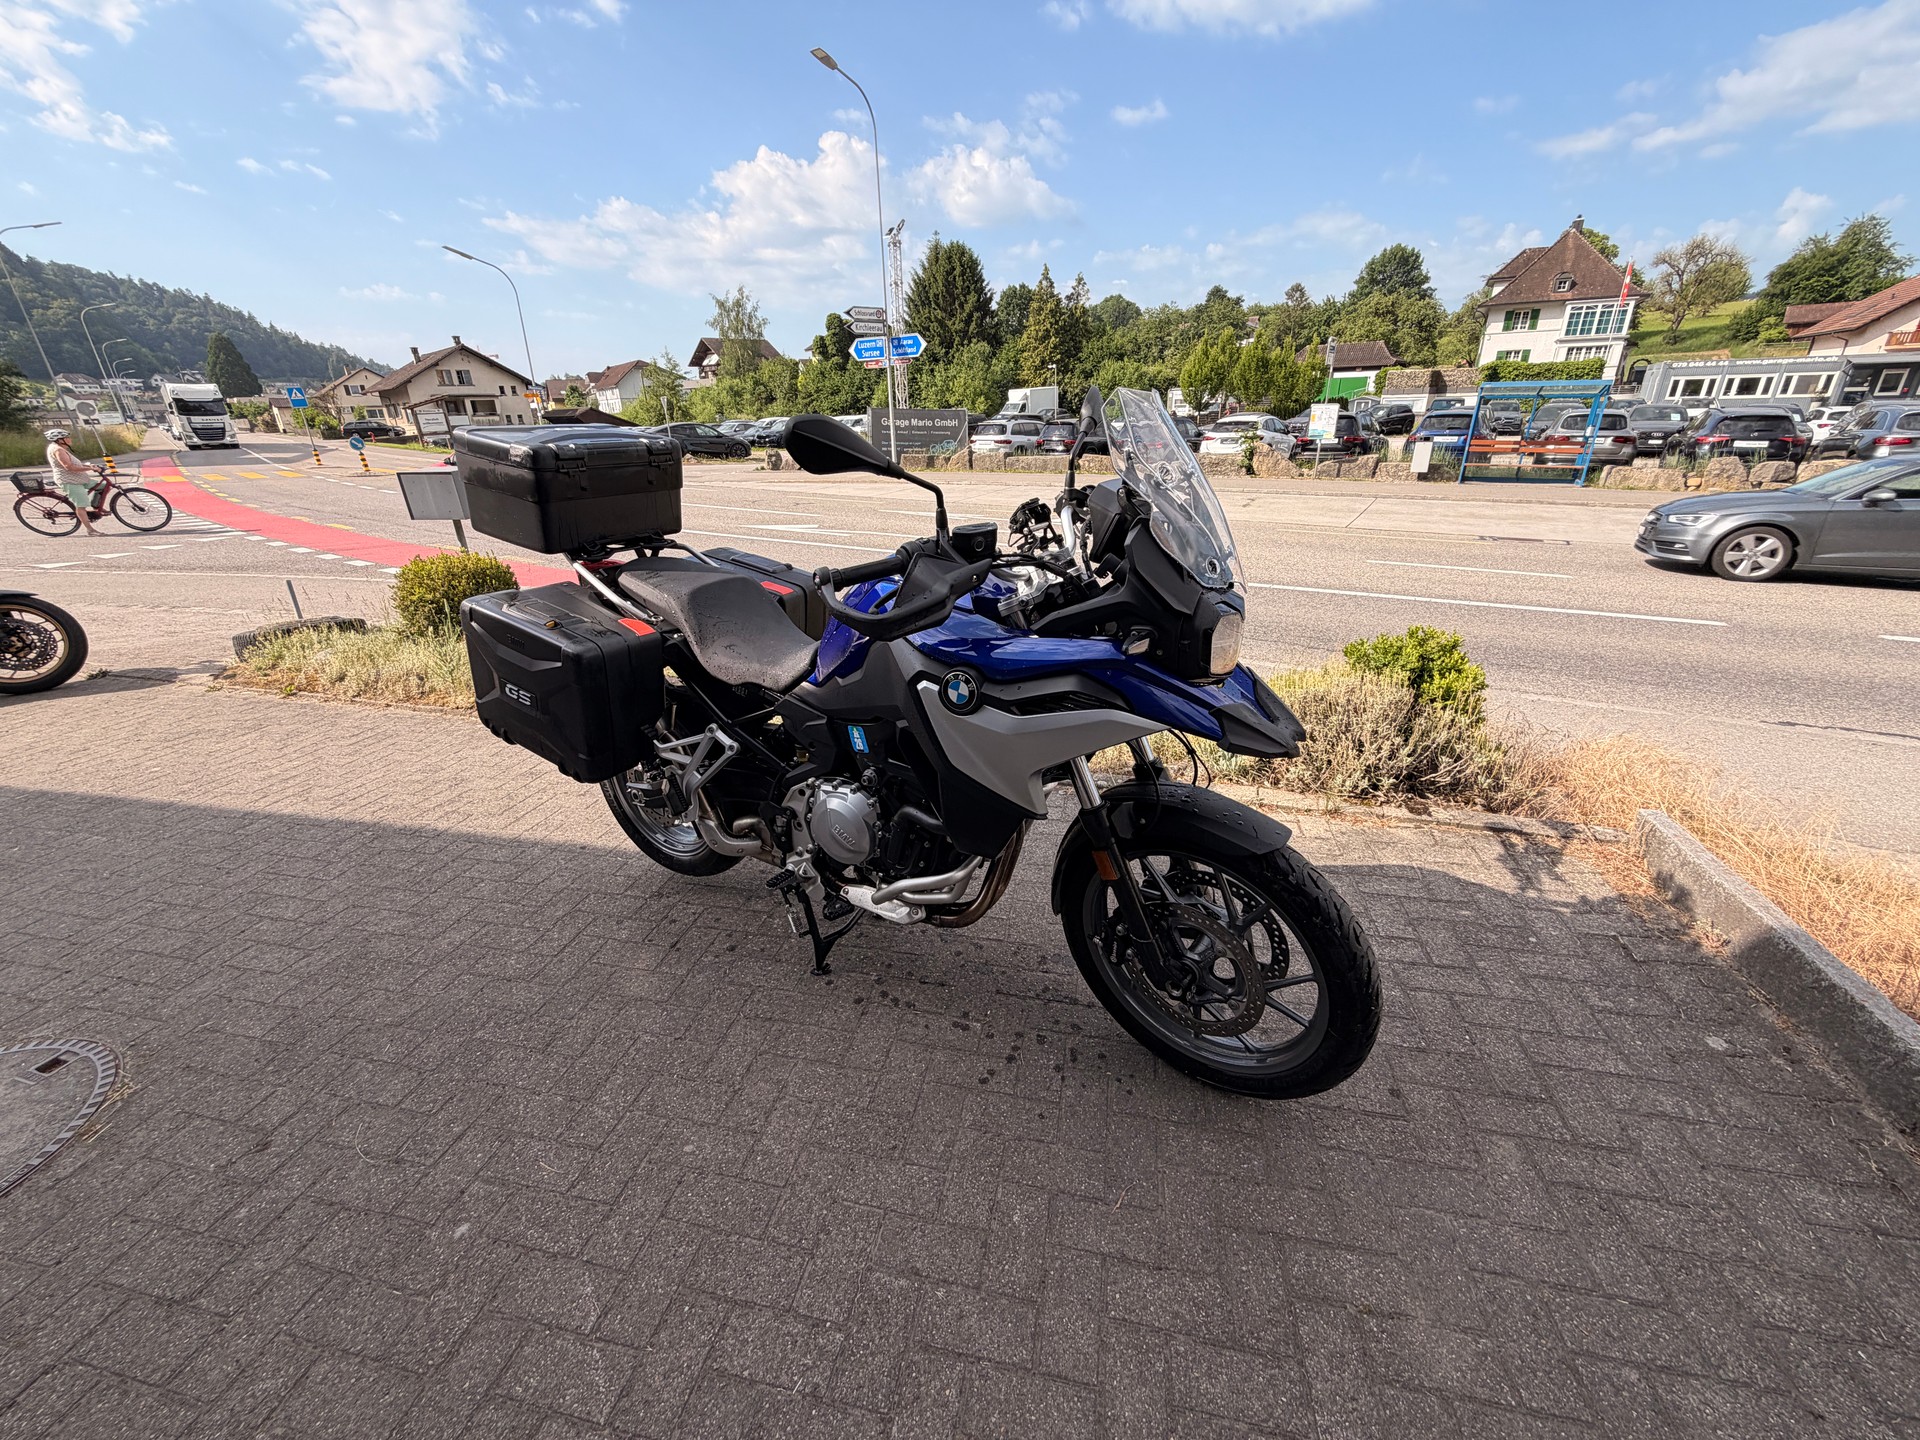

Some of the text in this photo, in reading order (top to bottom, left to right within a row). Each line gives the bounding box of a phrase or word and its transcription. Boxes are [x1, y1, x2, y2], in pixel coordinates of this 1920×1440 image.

[855, 323, 883, 332] Kirchleerau
[857, 341, 876, 349] Luzern
[1736, 356, 1839, 366] www.garage-mario.ch
[881, 417, 959, 428] Garage Mario GmbH
[947, 674, 975, 692] BMW
[504, 683, 532, 706] GS
[832, 824, 856, 847] BMW
